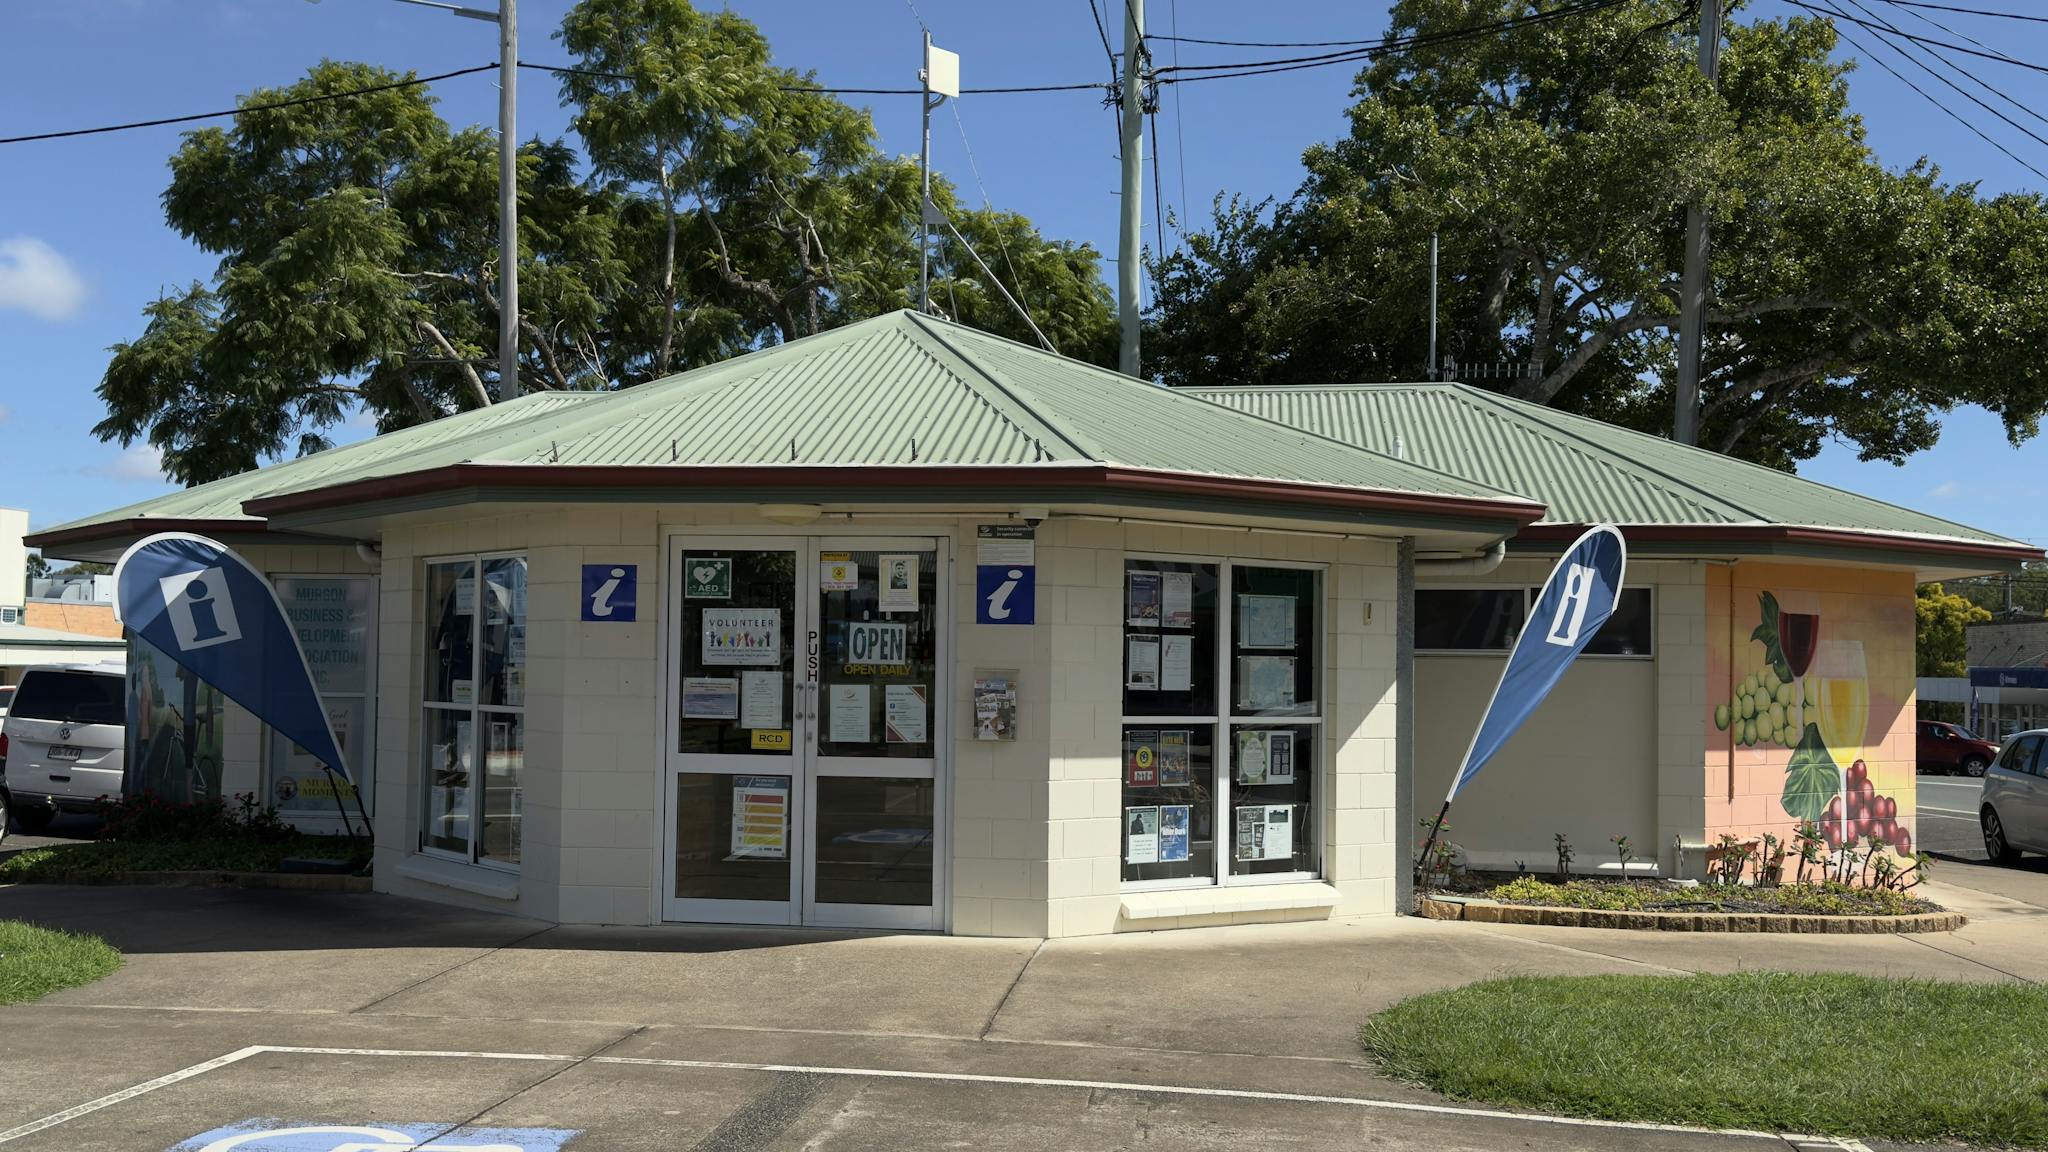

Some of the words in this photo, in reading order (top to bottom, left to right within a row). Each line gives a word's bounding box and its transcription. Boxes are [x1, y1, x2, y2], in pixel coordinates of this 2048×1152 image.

[296, 587, 347, 601] MURGON
[697, 584, 719, 592] AED
[709, 619, 775, 628] VOLUNTEER
[297, 629, 361, 642] ELOPMENT
[852, 627, 903, 660] OPEN
[305, 649, 359, 664] OCIATION
[807, 631, 818, 682] PUSH
[844, 664, 876, 675] OPEN
[880, 665, 912, 676] DAILY
[313, 670, 330, 685] NC.
[759, 735, 783, 743] RCD
